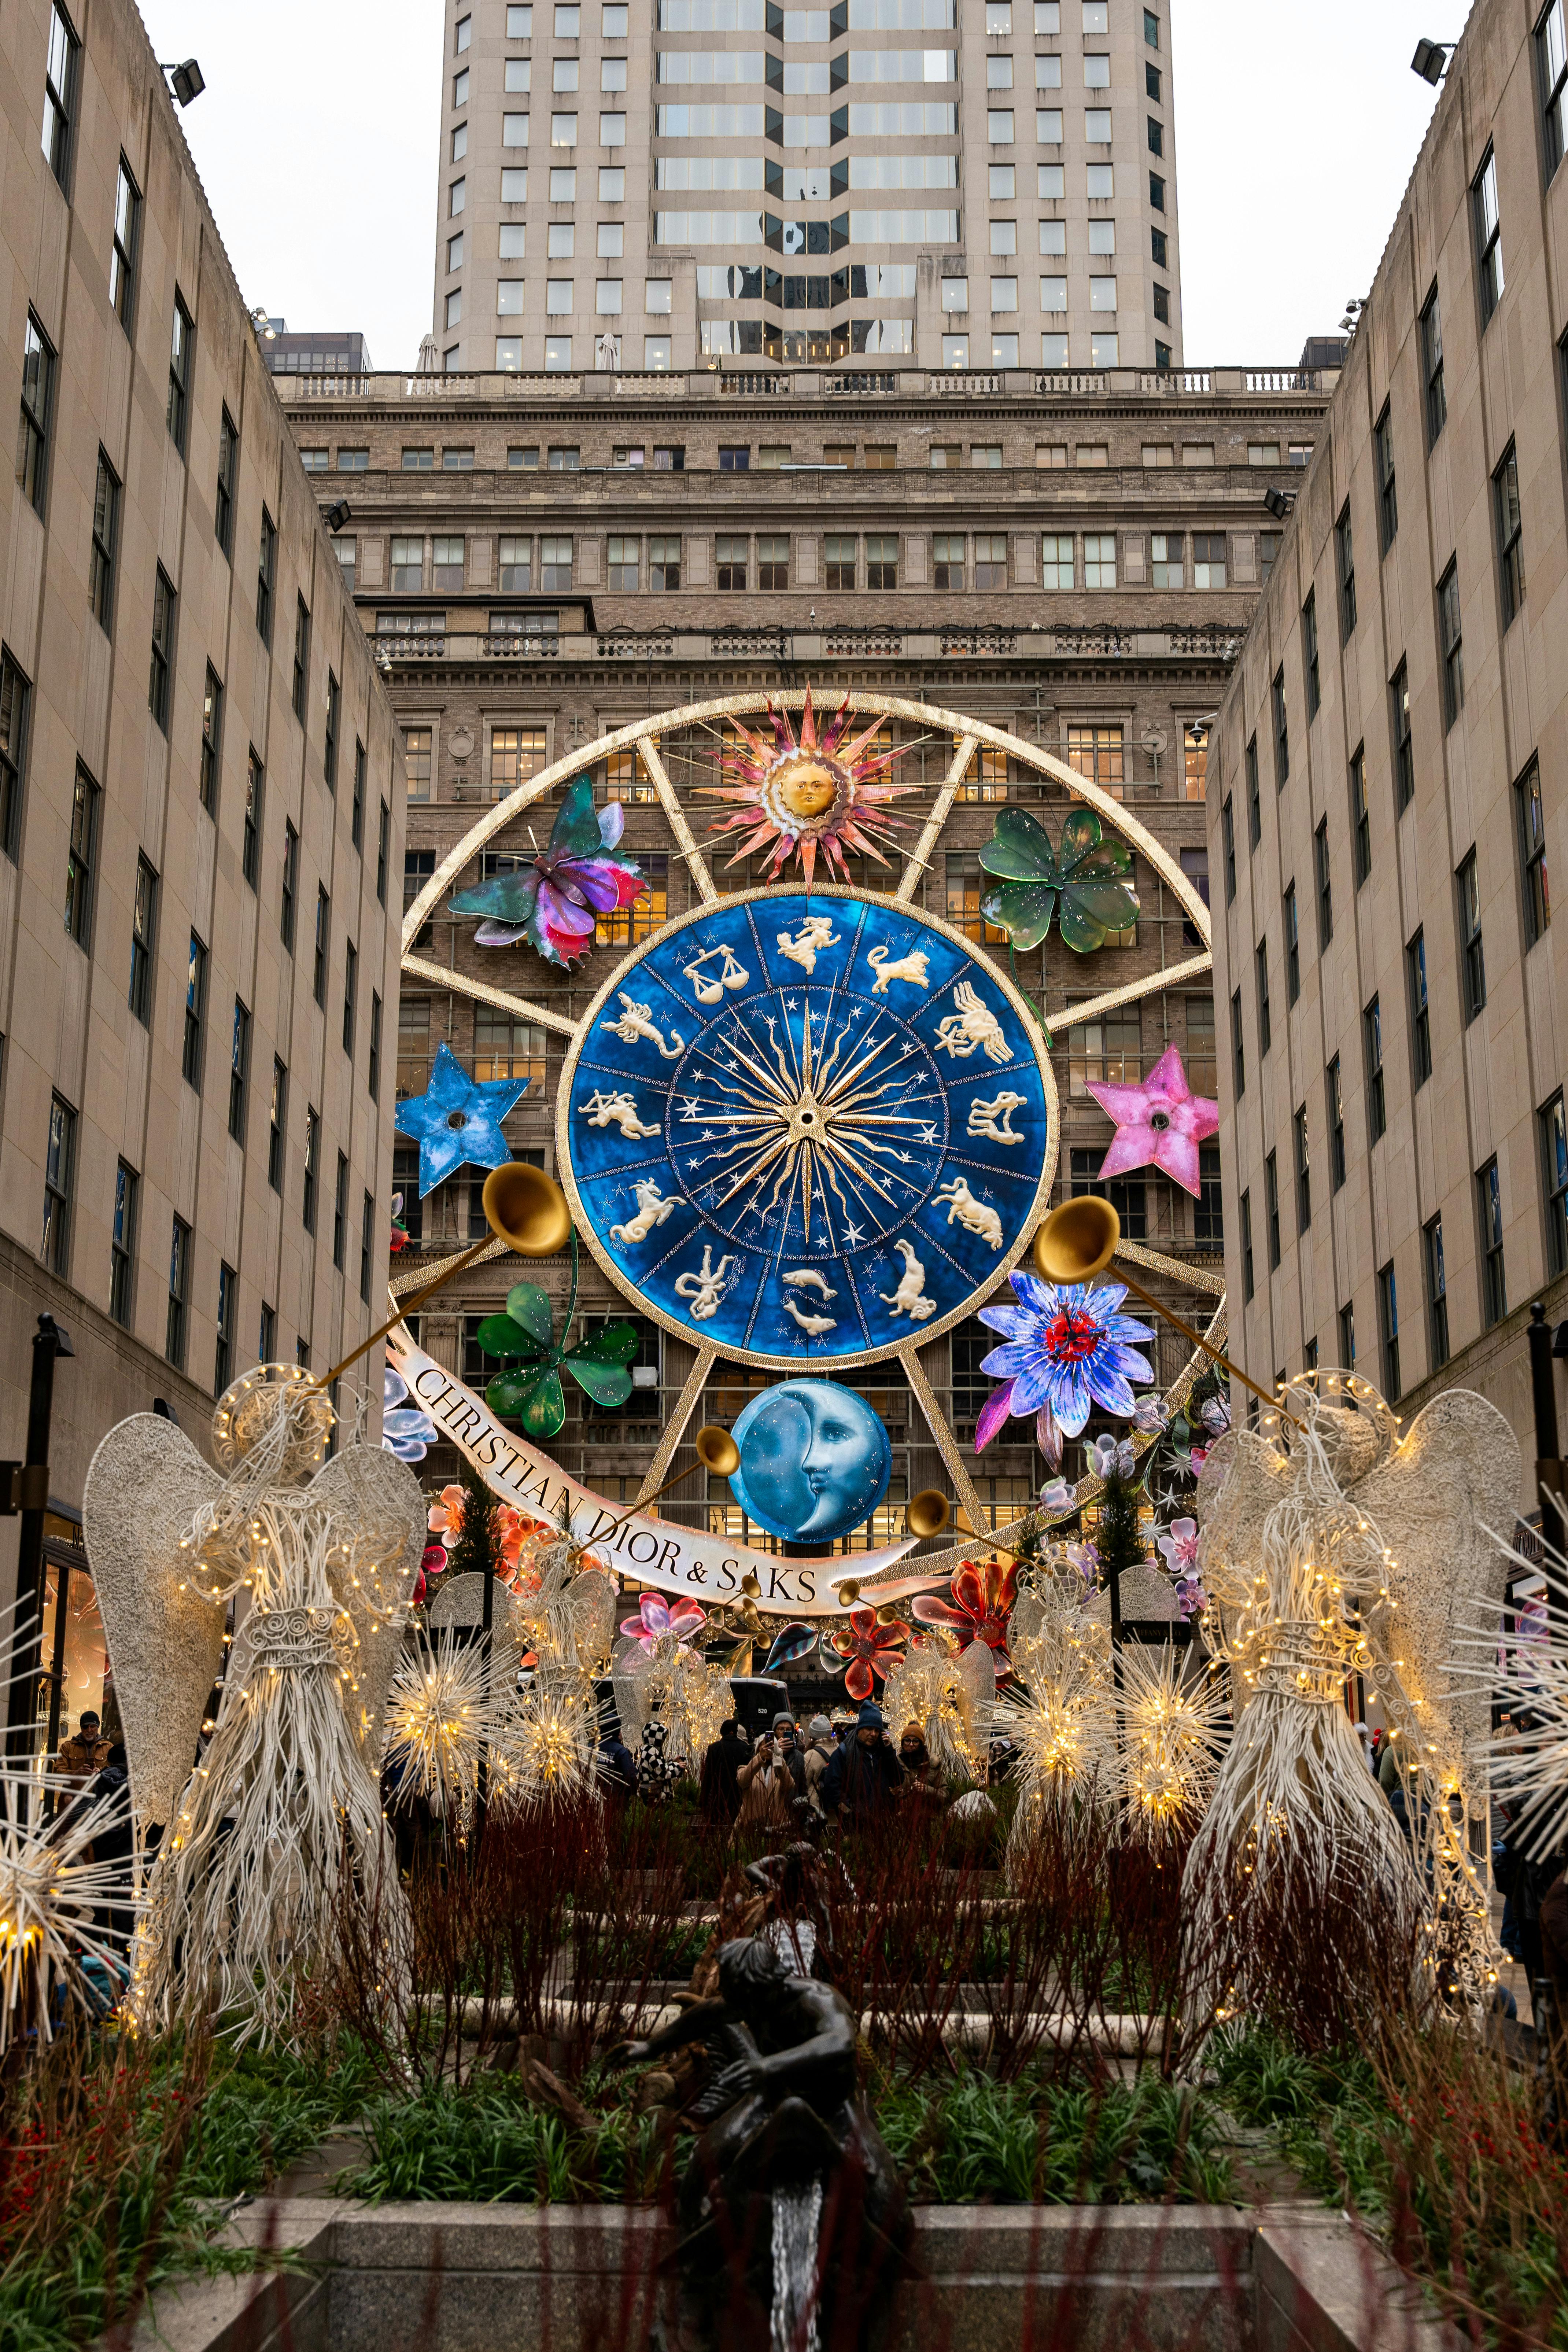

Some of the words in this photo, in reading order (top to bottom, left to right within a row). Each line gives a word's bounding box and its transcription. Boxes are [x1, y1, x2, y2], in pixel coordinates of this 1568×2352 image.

[415, 1369, 585, 1524] CHRISTIAN
[586, 1508, 681, 1577] DIOR
[686, 1561, 708, 1584] &
[716, 1559, 815, 1602] SAKS
[1135, 1628, 1161, 1636] IFFANY
